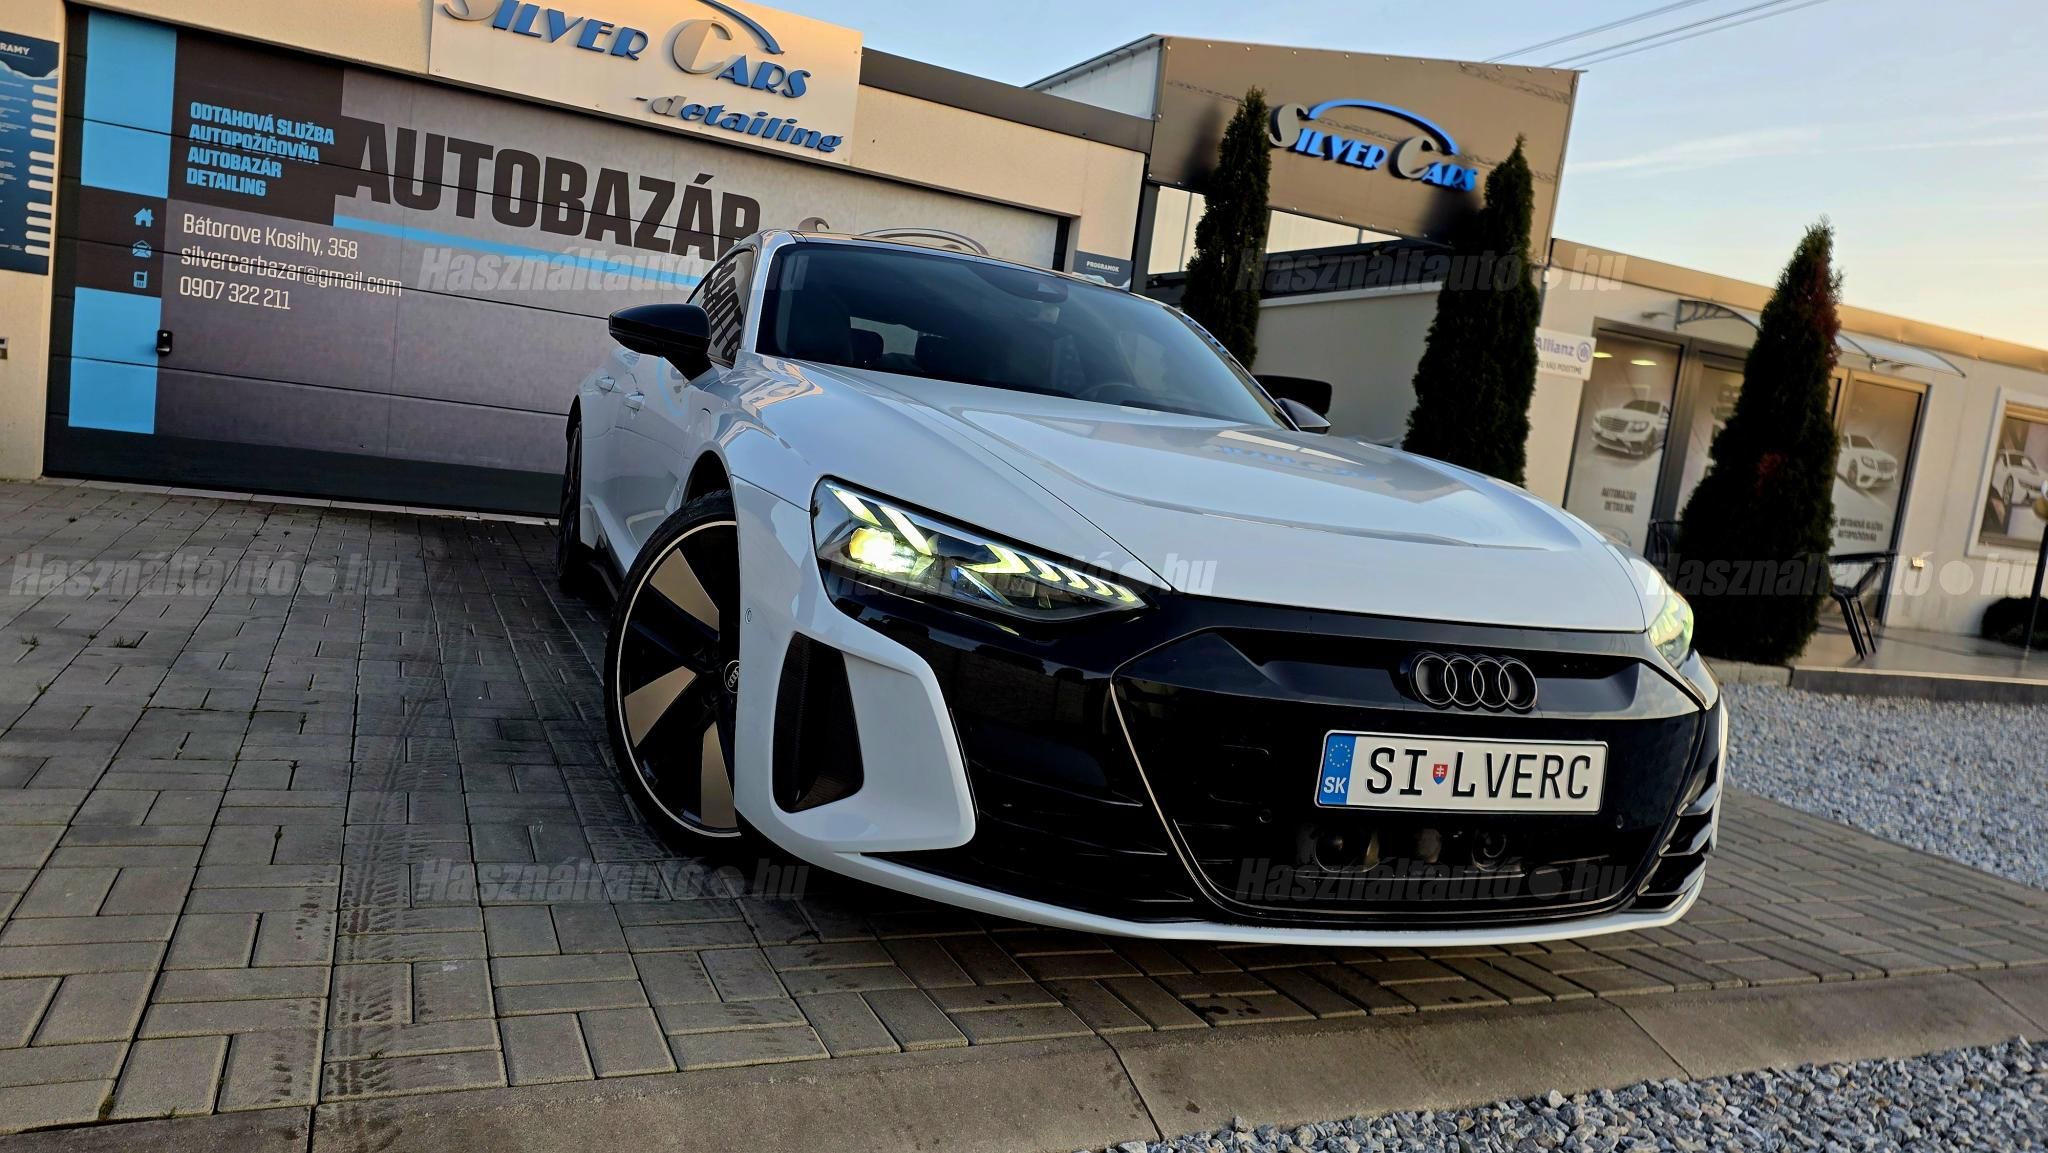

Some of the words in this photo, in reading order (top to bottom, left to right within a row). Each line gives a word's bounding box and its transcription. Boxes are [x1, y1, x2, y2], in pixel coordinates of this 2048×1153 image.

[672, 18, 811, 98] CARS
[188, 124, 320, 165] AUTOPOŽIČOVŇA
[190, 101, 275, 133] ODTAHOVÁ
[276, 118, 335, 145] SLUŽBA
[187, 146, 283, 178] AUTOBAZÁR
[1268, 103, 1388, 170] SILVER
[1396, 135, 1478, 191] CARS
[186, 167, 267, 197] DETAILING
[336, 120, 761, 262] AUTOBAZÁR
[183, 213, 261, 244] Bátorove
[265, 227, 323, 257] Kosihy,
[327, 237, 358, 260] 358
[179, 275, 225, 300] 0907
[228, 282, 260, 305] 322
[263, 288, 291, 310] 211
[181, 245, 402, 297] silvercarbazar@gmail.com
[1323, 776, 1347, 794] SK
